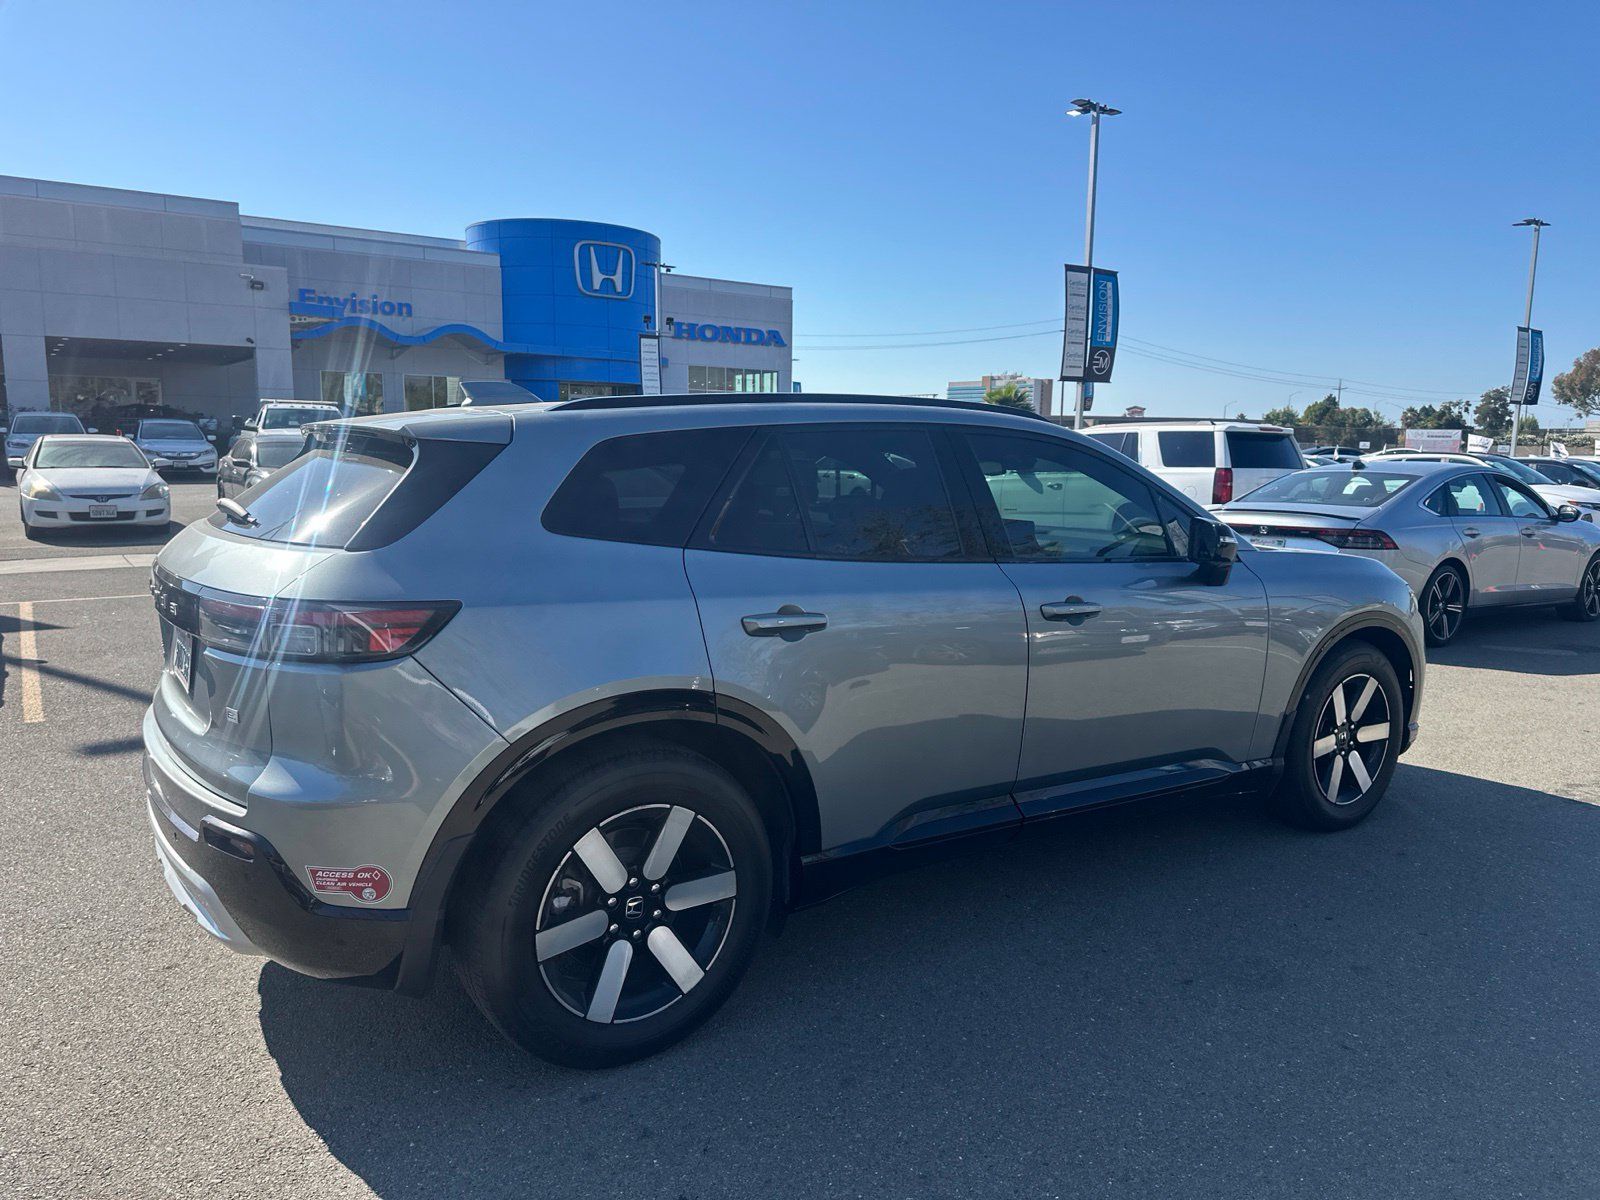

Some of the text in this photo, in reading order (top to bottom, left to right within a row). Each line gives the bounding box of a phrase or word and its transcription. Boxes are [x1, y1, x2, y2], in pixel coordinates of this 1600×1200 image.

[298, 288, 412, 317] Envision
[1097, 280, 1107, 342] ENVISION
[673, 321, 788, 347] HONDA
[316, 871, 354, 879] ACCESS
